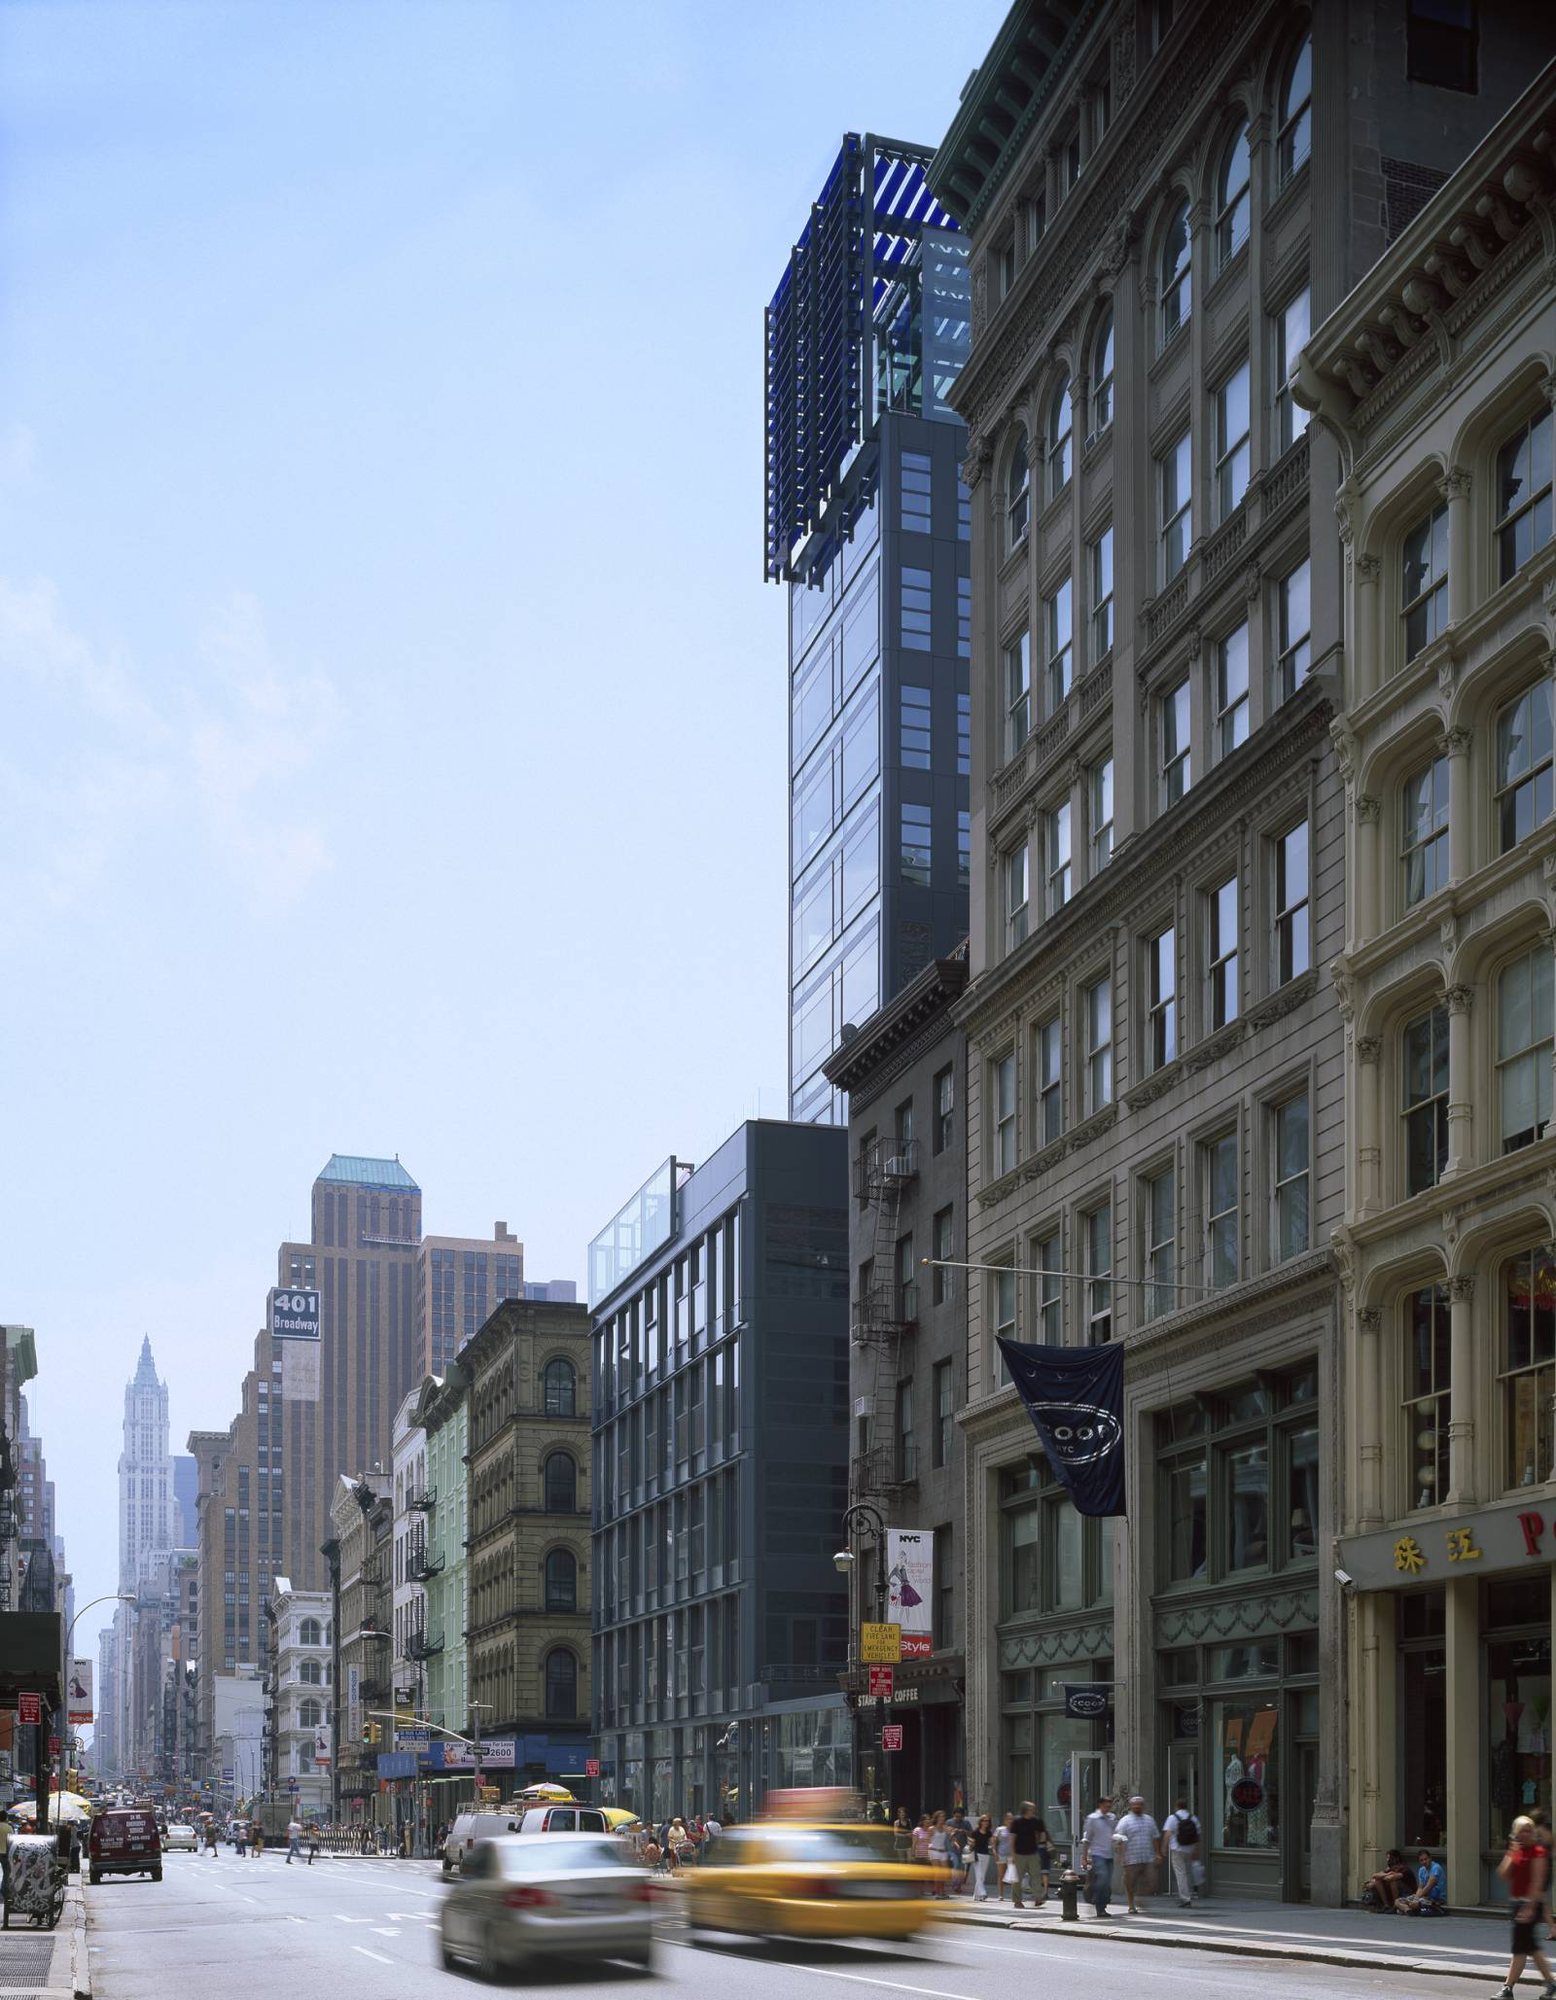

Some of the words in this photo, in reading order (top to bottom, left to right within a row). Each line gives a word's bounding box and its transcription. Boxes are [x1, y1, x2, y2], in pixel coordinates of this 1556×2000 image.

[274, 1294, 316, 1313] 401
[274, 1315, 318, 1334] Broadway
[899, 1535, 921, 1543] NYC
[858, 1694, 892, 1707] STARBKS
[894, 1688, 919, 1702] COFFEE
